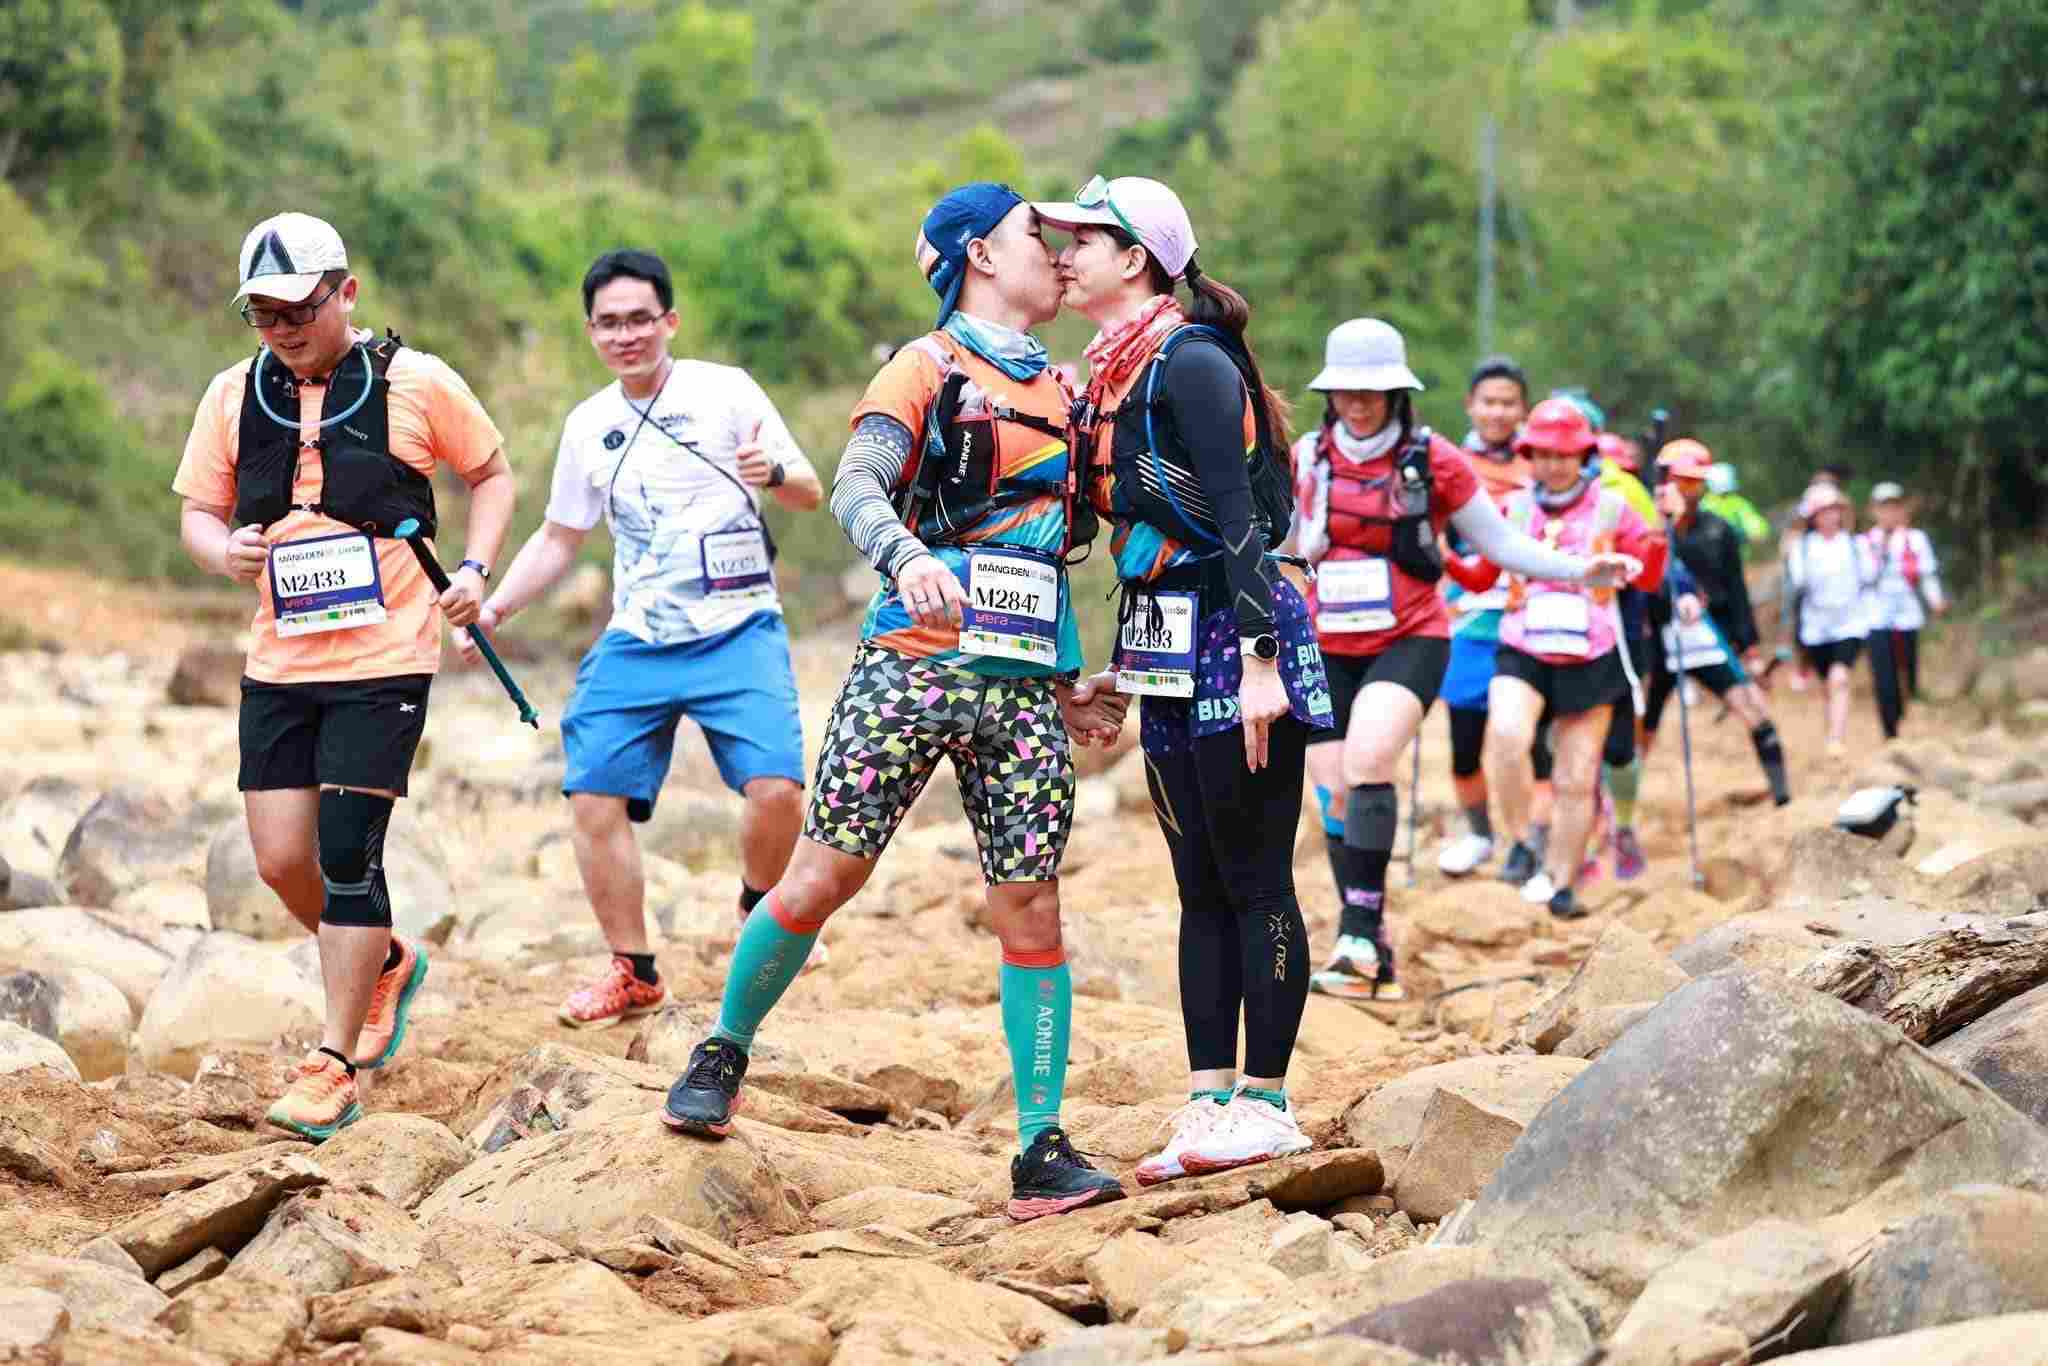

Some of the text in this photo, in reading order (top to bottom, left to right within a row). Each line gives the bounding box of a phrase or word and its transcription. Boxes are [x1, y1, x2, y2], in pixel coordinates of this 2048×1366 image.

[281, 569, 346, 593] M2433
[976, 587, 1040, 614] M2847
[1274, 944, 1287, 982] 2XU
[1033, 1004, 1055, 1077] AONIJIE
